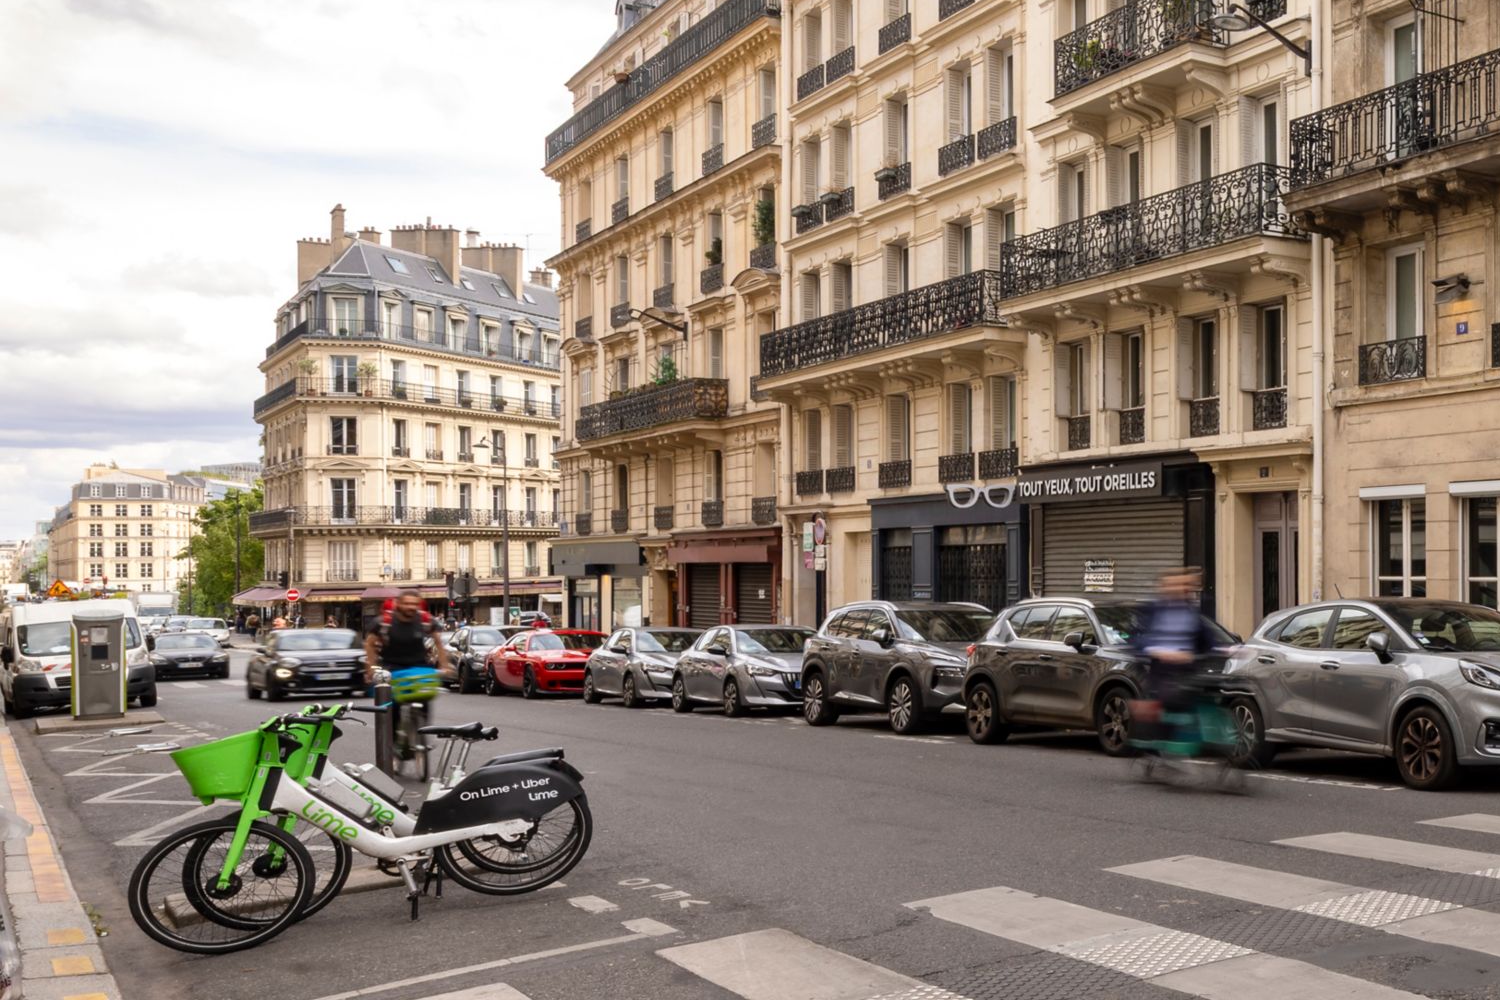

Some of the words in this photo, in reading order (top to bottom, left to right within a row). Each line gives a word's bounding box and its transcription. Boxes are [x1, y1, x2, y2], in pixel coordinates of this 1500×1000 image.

[1019, 480, 1043, 497] TOUT
[1044, 478, 1073, 495] YEUX,
[1075, 475, 1102, 493] TOUT
[1103, 471, 1155, 490] OREILLES
[460, 791, 480, 801] On
[480, 785, 510, 797] Lime
[521, 778, 551, 789] Uber
[302, 800, 358, 841] Lime
